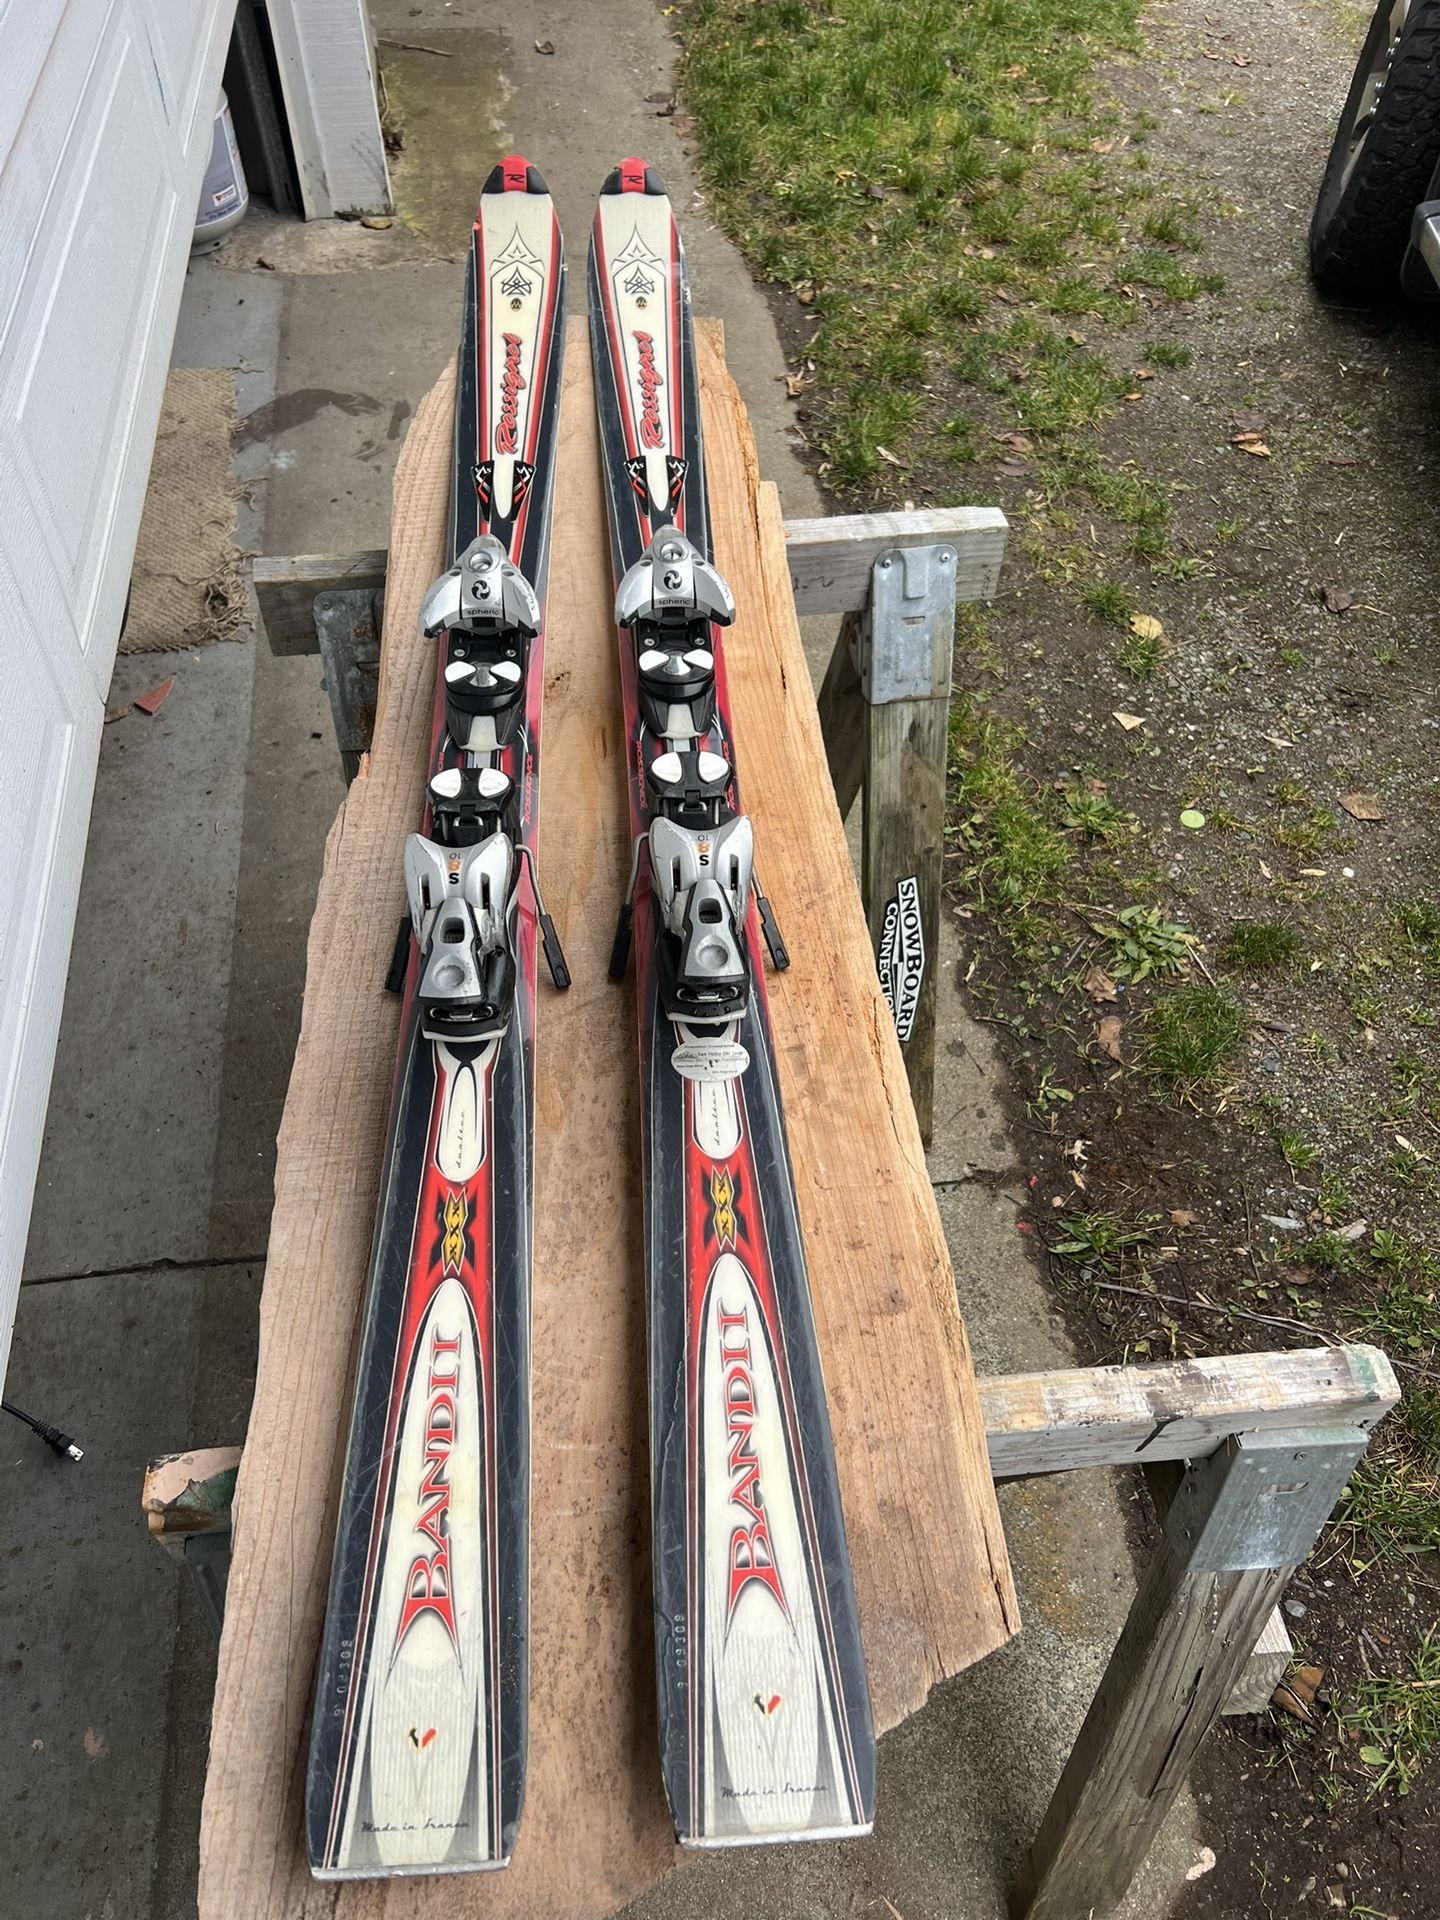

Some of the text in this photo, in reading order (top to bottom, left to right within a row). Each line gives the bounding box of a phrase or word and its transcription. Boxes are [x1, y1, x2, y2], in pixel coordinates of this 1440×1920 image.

[495, 331, 526, 456] Rossignol
[632, 329, 665, 449] Rossignol
[466, 608, 500, 616] spheric
[658, 598, 690, 606] spheric
[879, 903, 898, 1010] CONNECTI
[897, 882, 922, 1038] SNOWBOARD
[361, 1820, 399, 1833] Made
[402, 1822, 417, 1831] in
